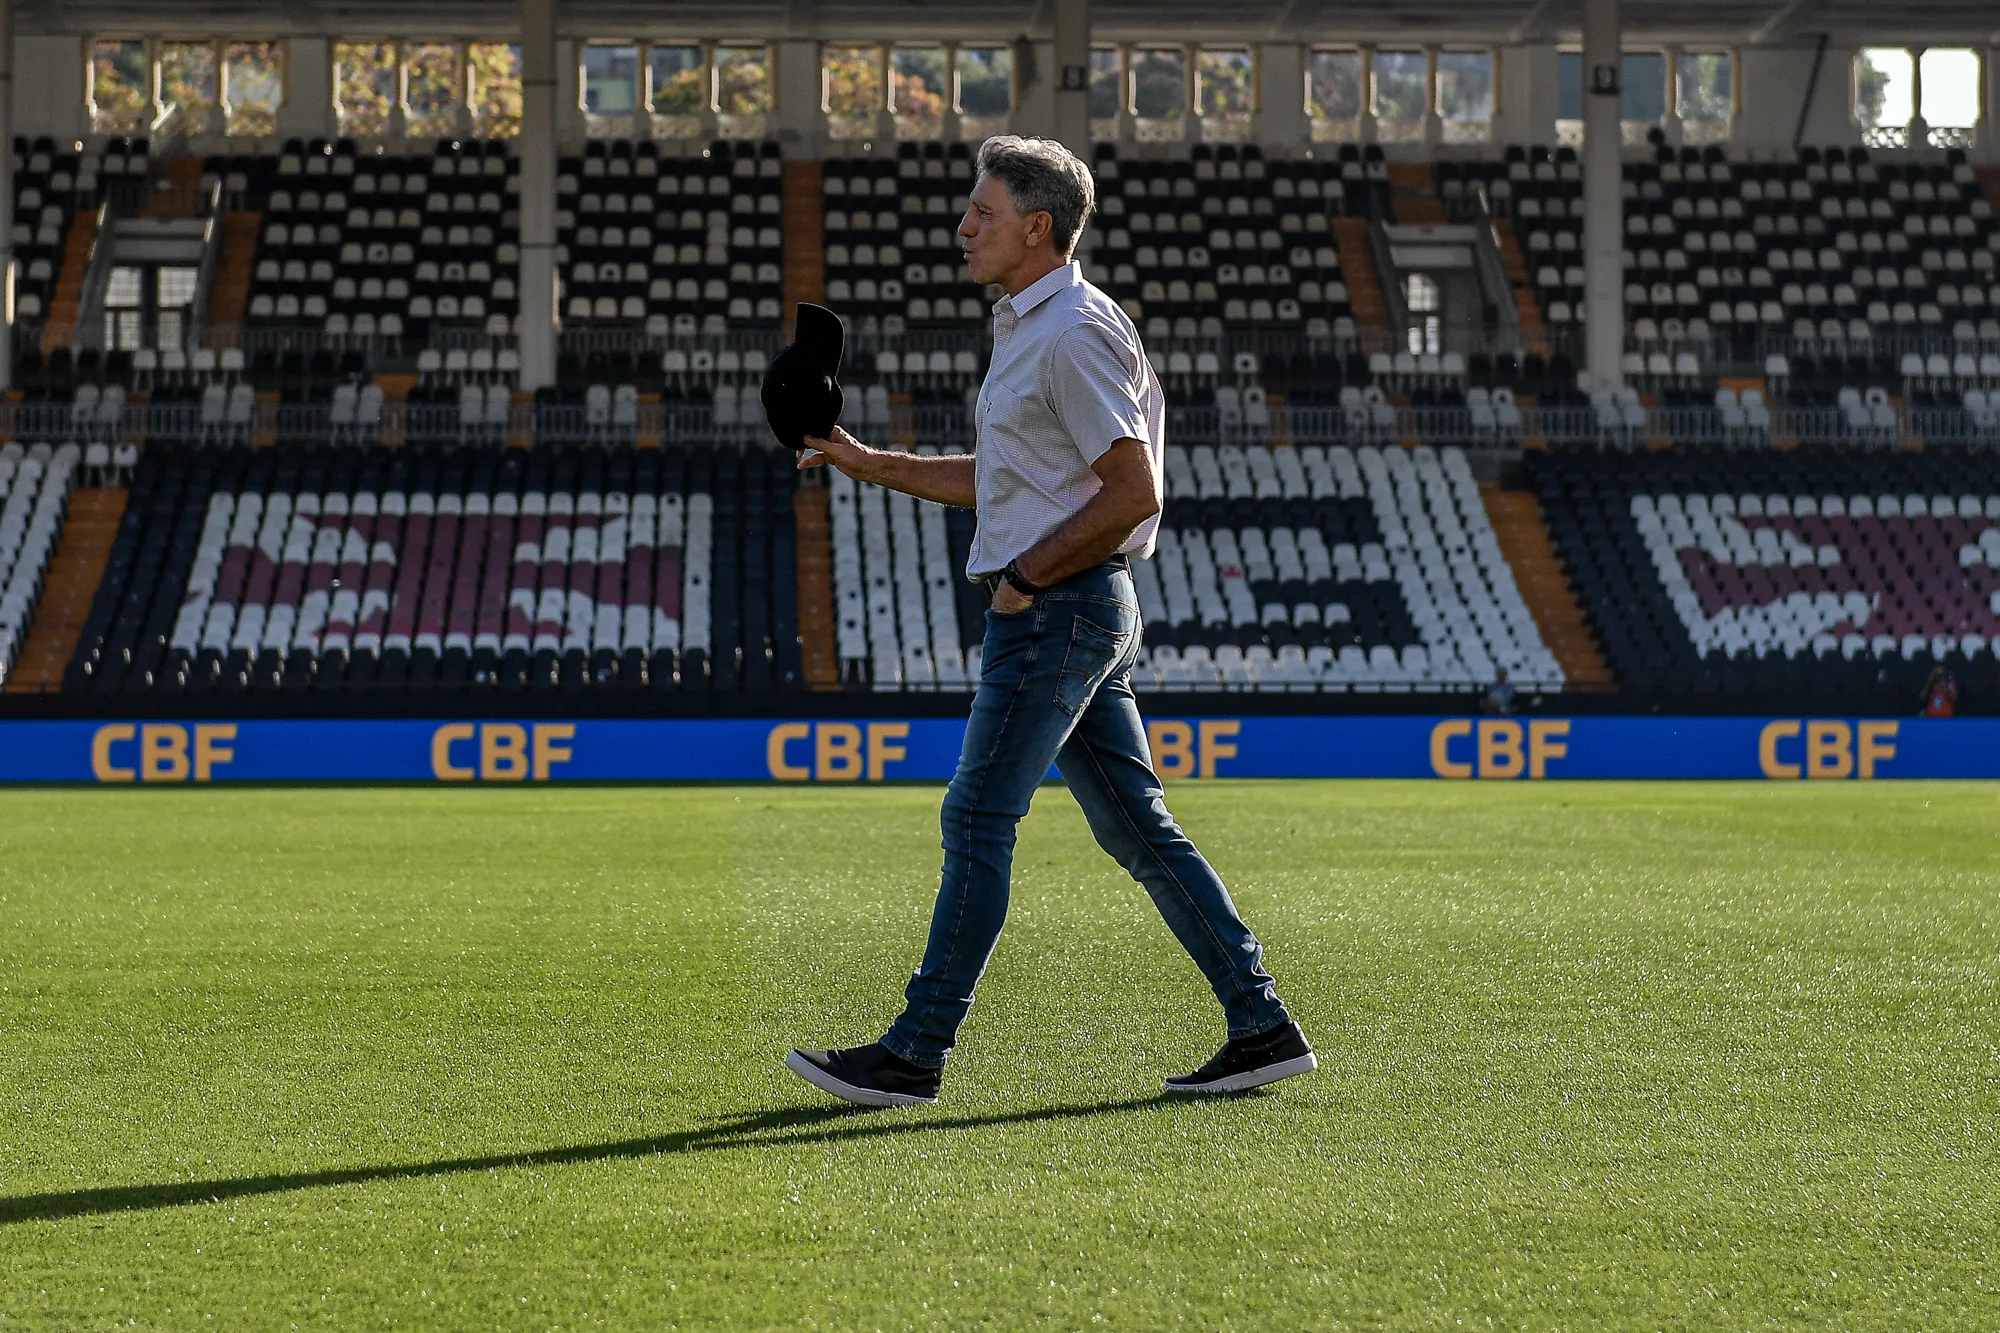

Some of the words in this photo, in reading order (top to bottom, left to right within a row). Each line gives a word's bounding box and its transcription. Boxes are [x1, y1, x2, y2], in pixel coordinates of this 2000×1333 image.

[92, 723, 237, 780] CBF
[432, 723, 575, 779] CBF
[768, 722, 909, 779] CBF
[1147, 720, 1240, 777] BF
[1430, 719, 1571, 778] CBF
[1759, 721, 1899, 777] CBF
